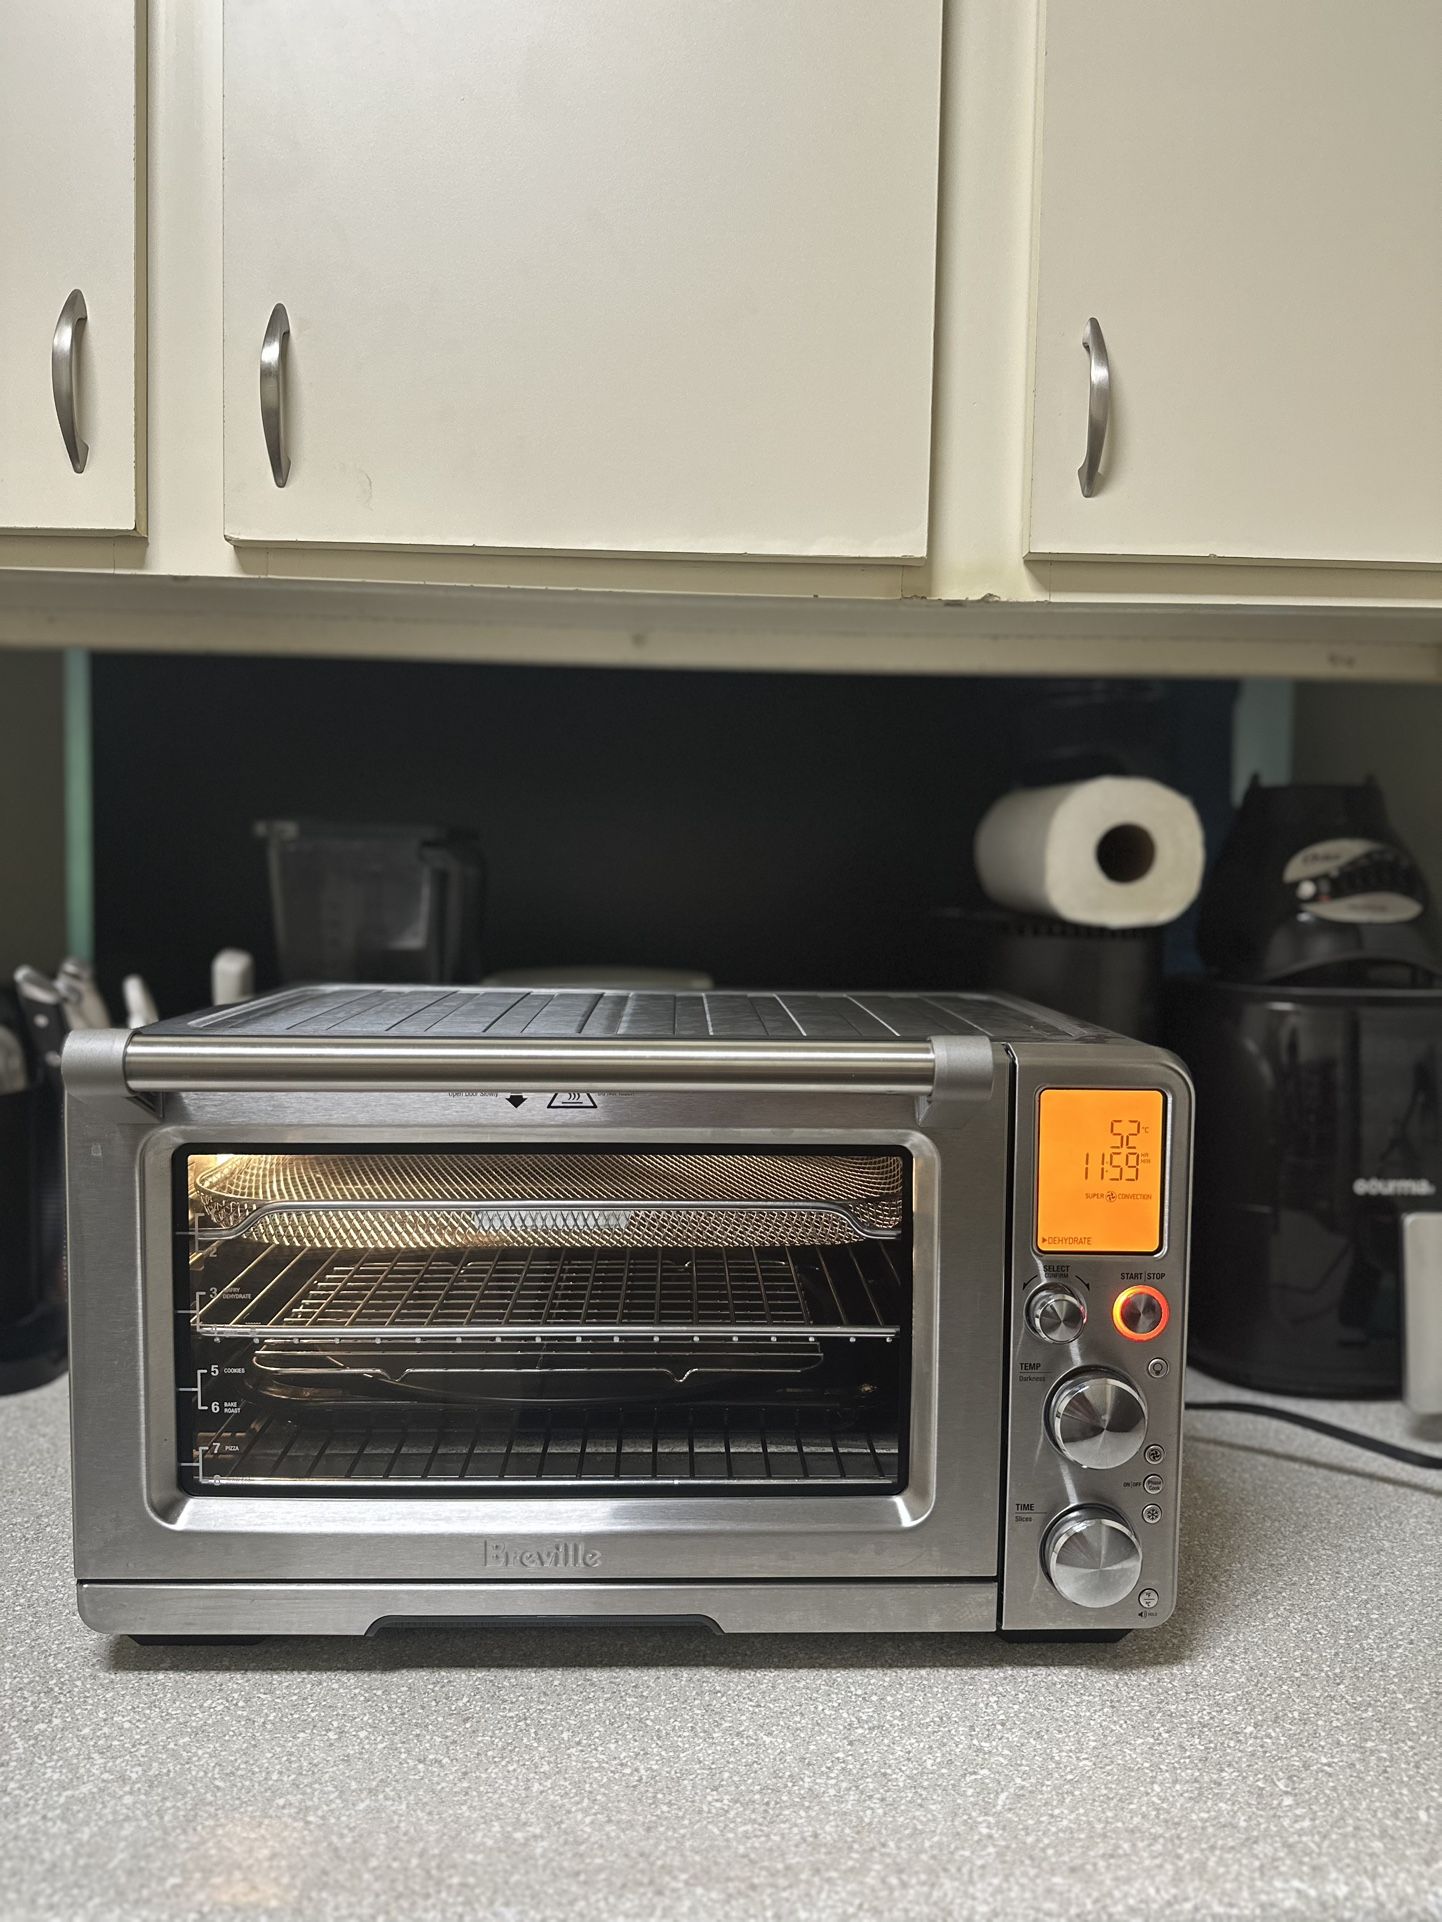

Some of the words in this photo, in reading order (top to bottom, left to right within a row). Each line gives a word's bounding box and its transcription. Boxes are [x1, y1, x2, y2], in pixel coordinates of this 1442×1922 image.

[1110, 1119, 1141, 1149] 52
[1085, 1192, 1104, 1200] SUPER
[1117, 1192, 1152, 1200] CONVECTION
[1047, 1236, 1092, 1245] DEHYDRATE
[209, 1247, 217, 1257] 2
[1043, 1264, 1070, 1273] SELECT
[1120, 1272, 1143, 1280] START
[1147, 1272, 1166, 1280] STOP
[210, 1286, 218, 1299] 3
[210, 1364, 219, 1377] 5
[1019, 1362, 1041, 1371] TEMP
[211, 1401, 220, 1414] 6
[212, 1442, 221, 1454] 7
[1015, 1503, 1035, 1511] TIME
[1014, 1515, 1032, 1523] Slices
[482, 1539, 602, 1568] Breville
